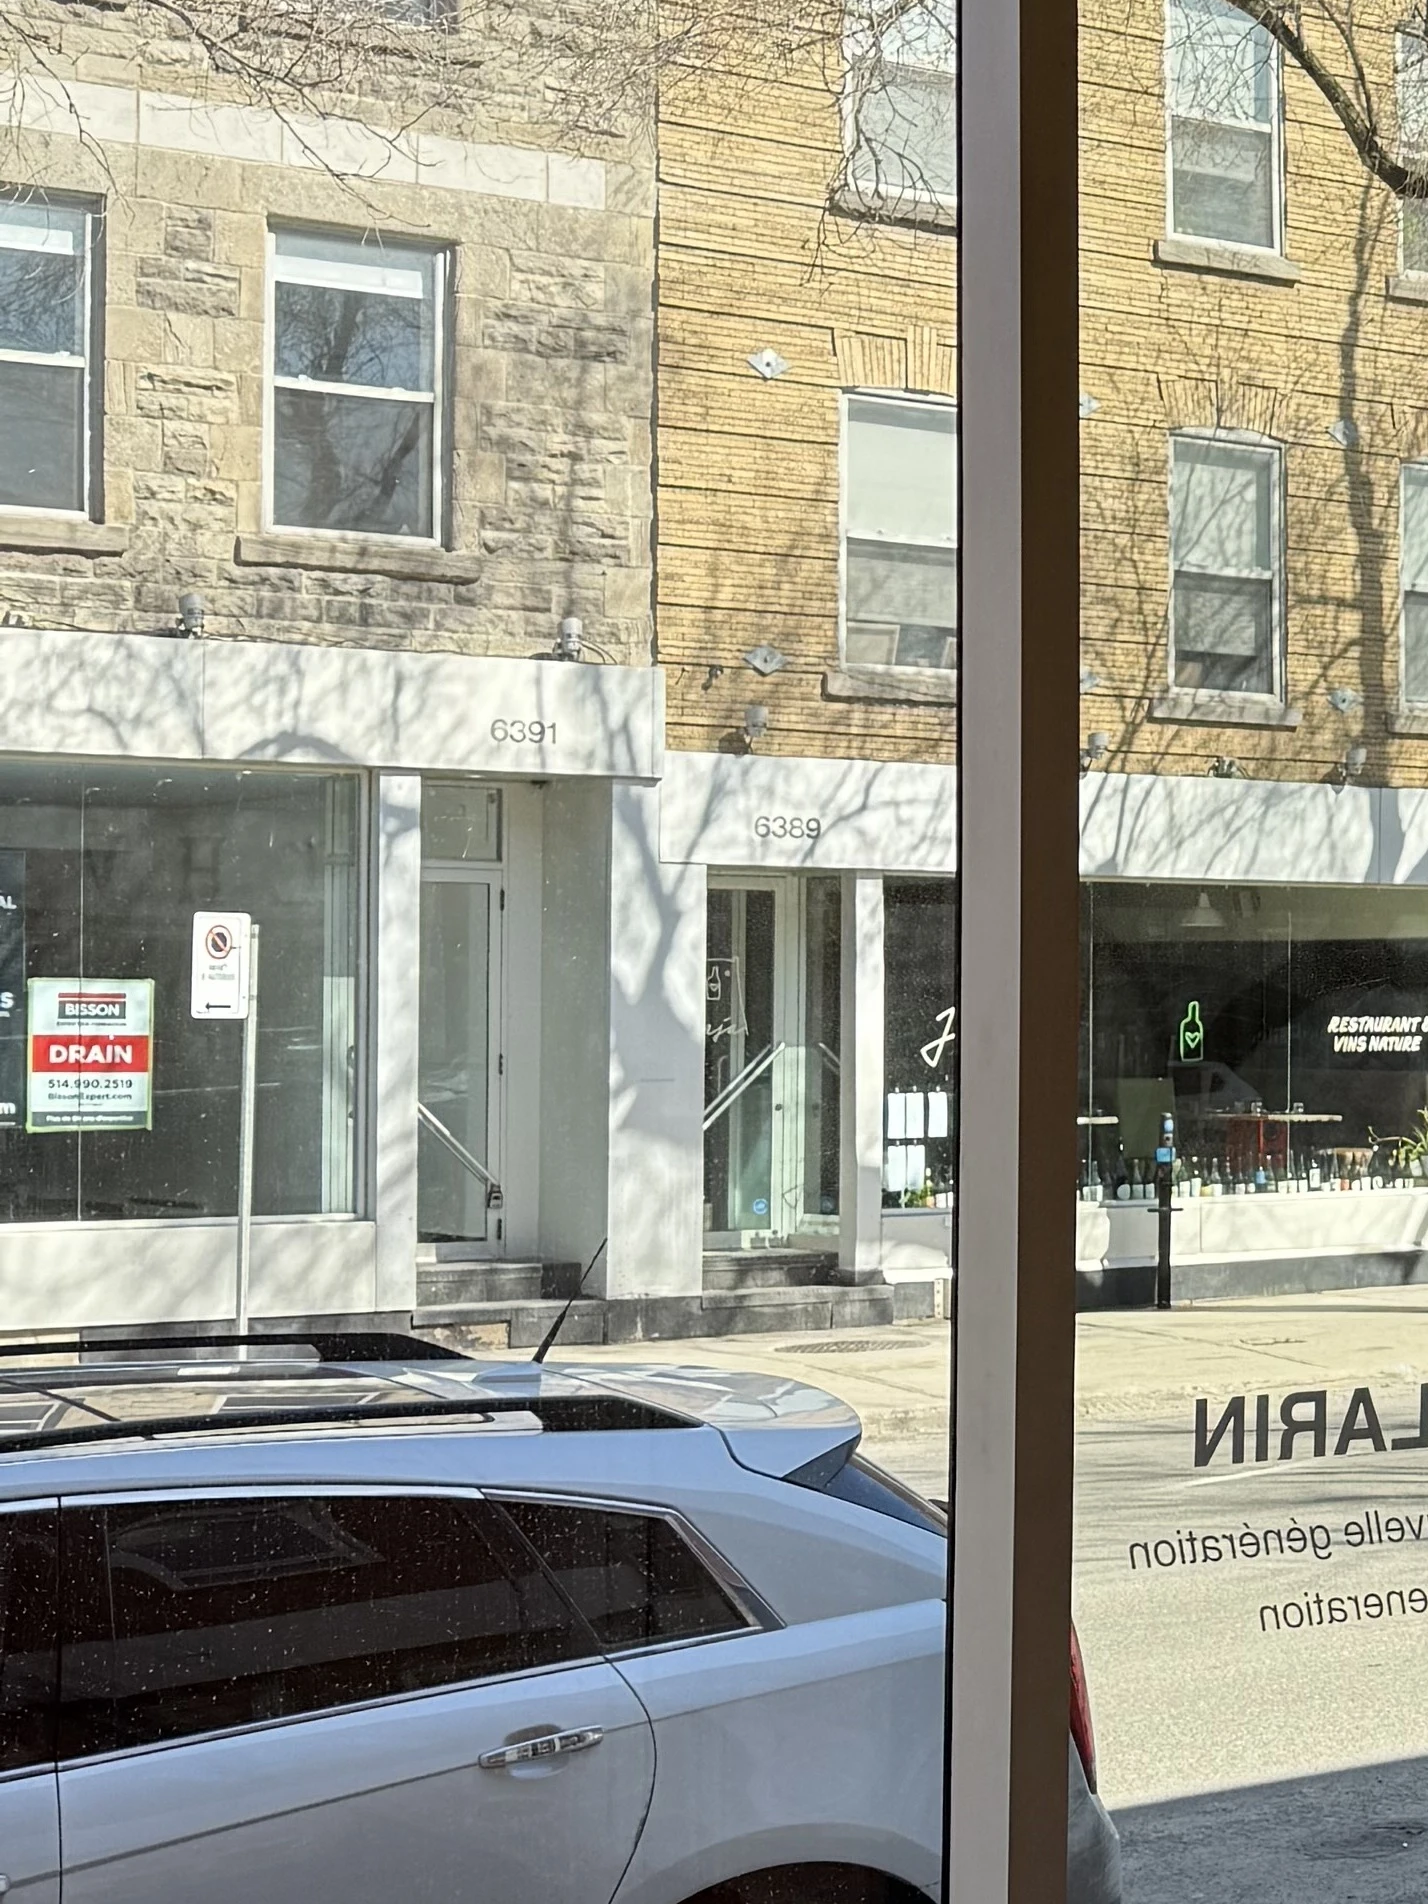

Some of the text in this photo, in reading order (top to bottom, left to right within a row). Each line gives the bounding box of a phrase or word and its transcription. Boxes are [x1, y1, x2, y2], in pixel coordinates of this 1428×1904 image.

[490, 718, 557, 744] 6391
[754, 816, 822, 839] 6389
[64, 1003, 120, 1016] BISSON
[1327, 1015, 1421, 1033] RESTAURANT
[1333, 1035, 1422, 1053] VINS NATURE
[49, 1044, 133, 1064] DRAIN
[48, 1079, 133, 1089] 514.990.2519
